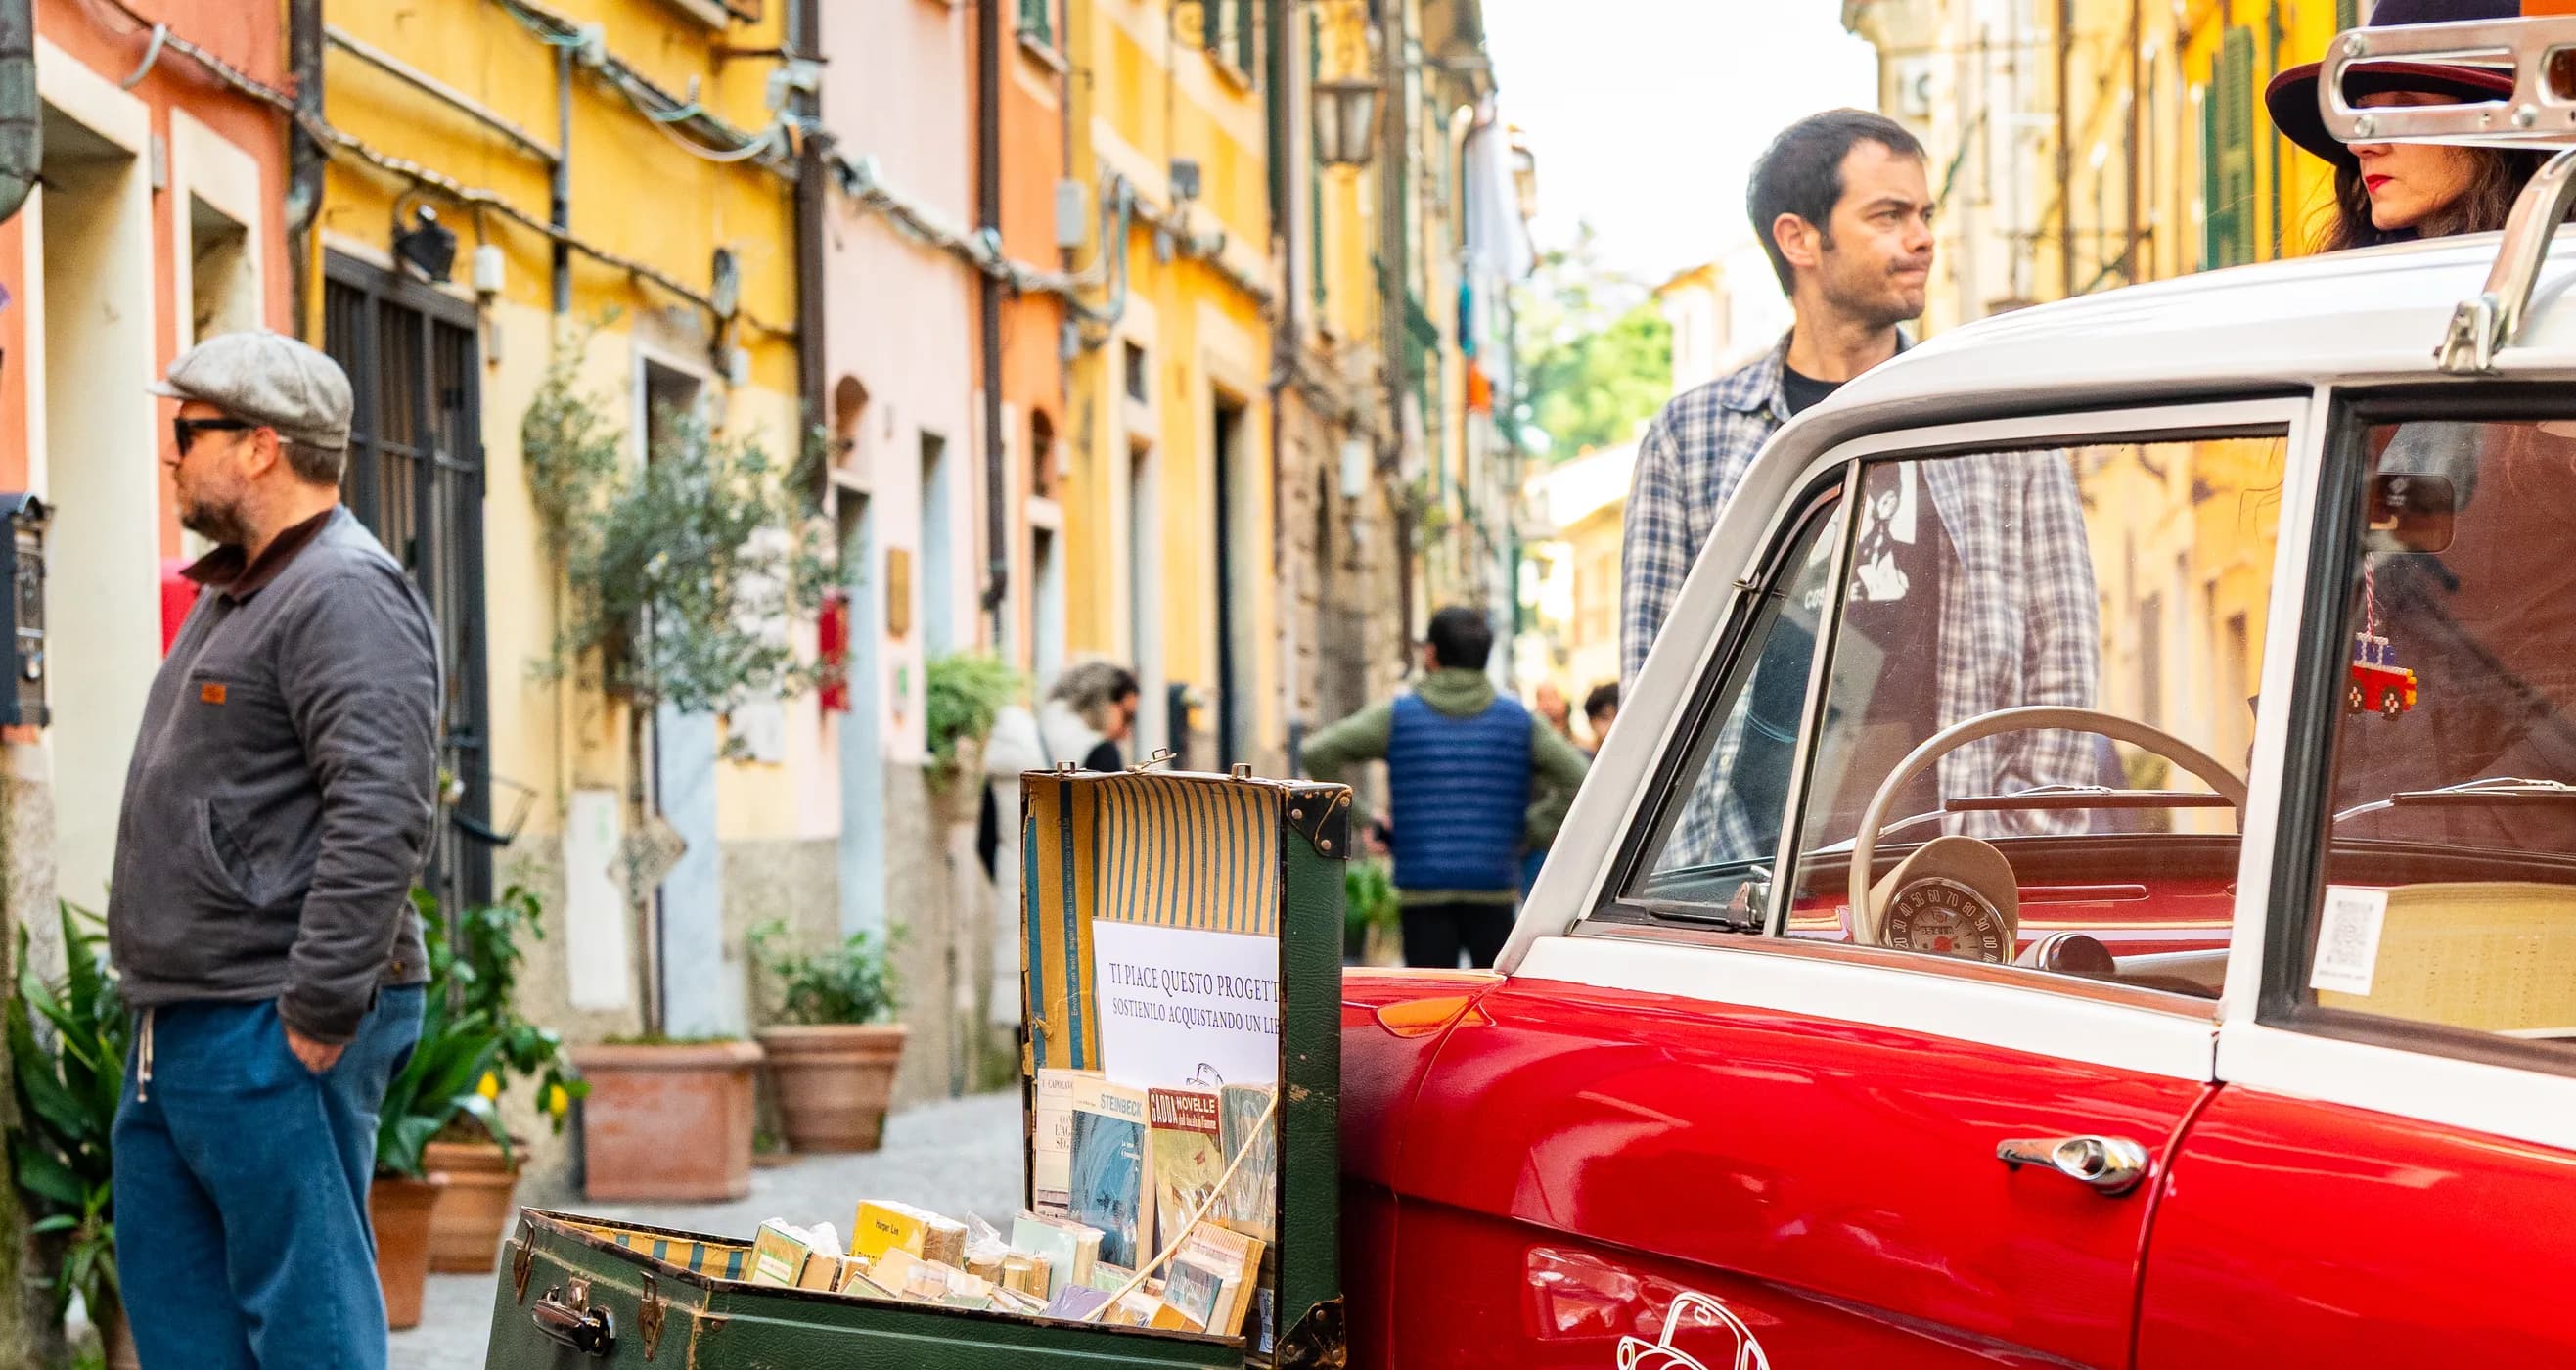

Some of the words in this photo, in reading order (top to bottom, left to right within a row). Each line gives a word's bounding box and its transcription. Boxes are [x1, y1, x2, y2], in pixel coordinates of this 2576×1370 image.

[1910, 891, 1925, 907] 50
[1927, 890, 1940, 902] 60
[1946, 890, 1959, 907] 70
[1899, 902, 1914, 917] 40
[1962, 901, 1977, 917] 80
[1892, 918, 1907, 933] 30
[1974, 917, 1991, 932] 90
[1982, 935, 1998, 949] 100
[1109, 962, 1122, 984] TI
[1124, 963, 1158, 989] PIACE
[1161, 969, 1213, 998] QUESTO
[1112, 998, 1166, 1022] SOSTIENILO
[1168, 1005, 1243, 1030] ACQUISTANDO
[1245, 1014, 1262, 1033] UN
[1100, 1094, 1142, 1118] STEINBECK
[1151, 1093, 1178, 1124] GADDA
[1176, 1096, 1215, 1114] NOVELLE
[876, 1220, 889, 1232] Harper
